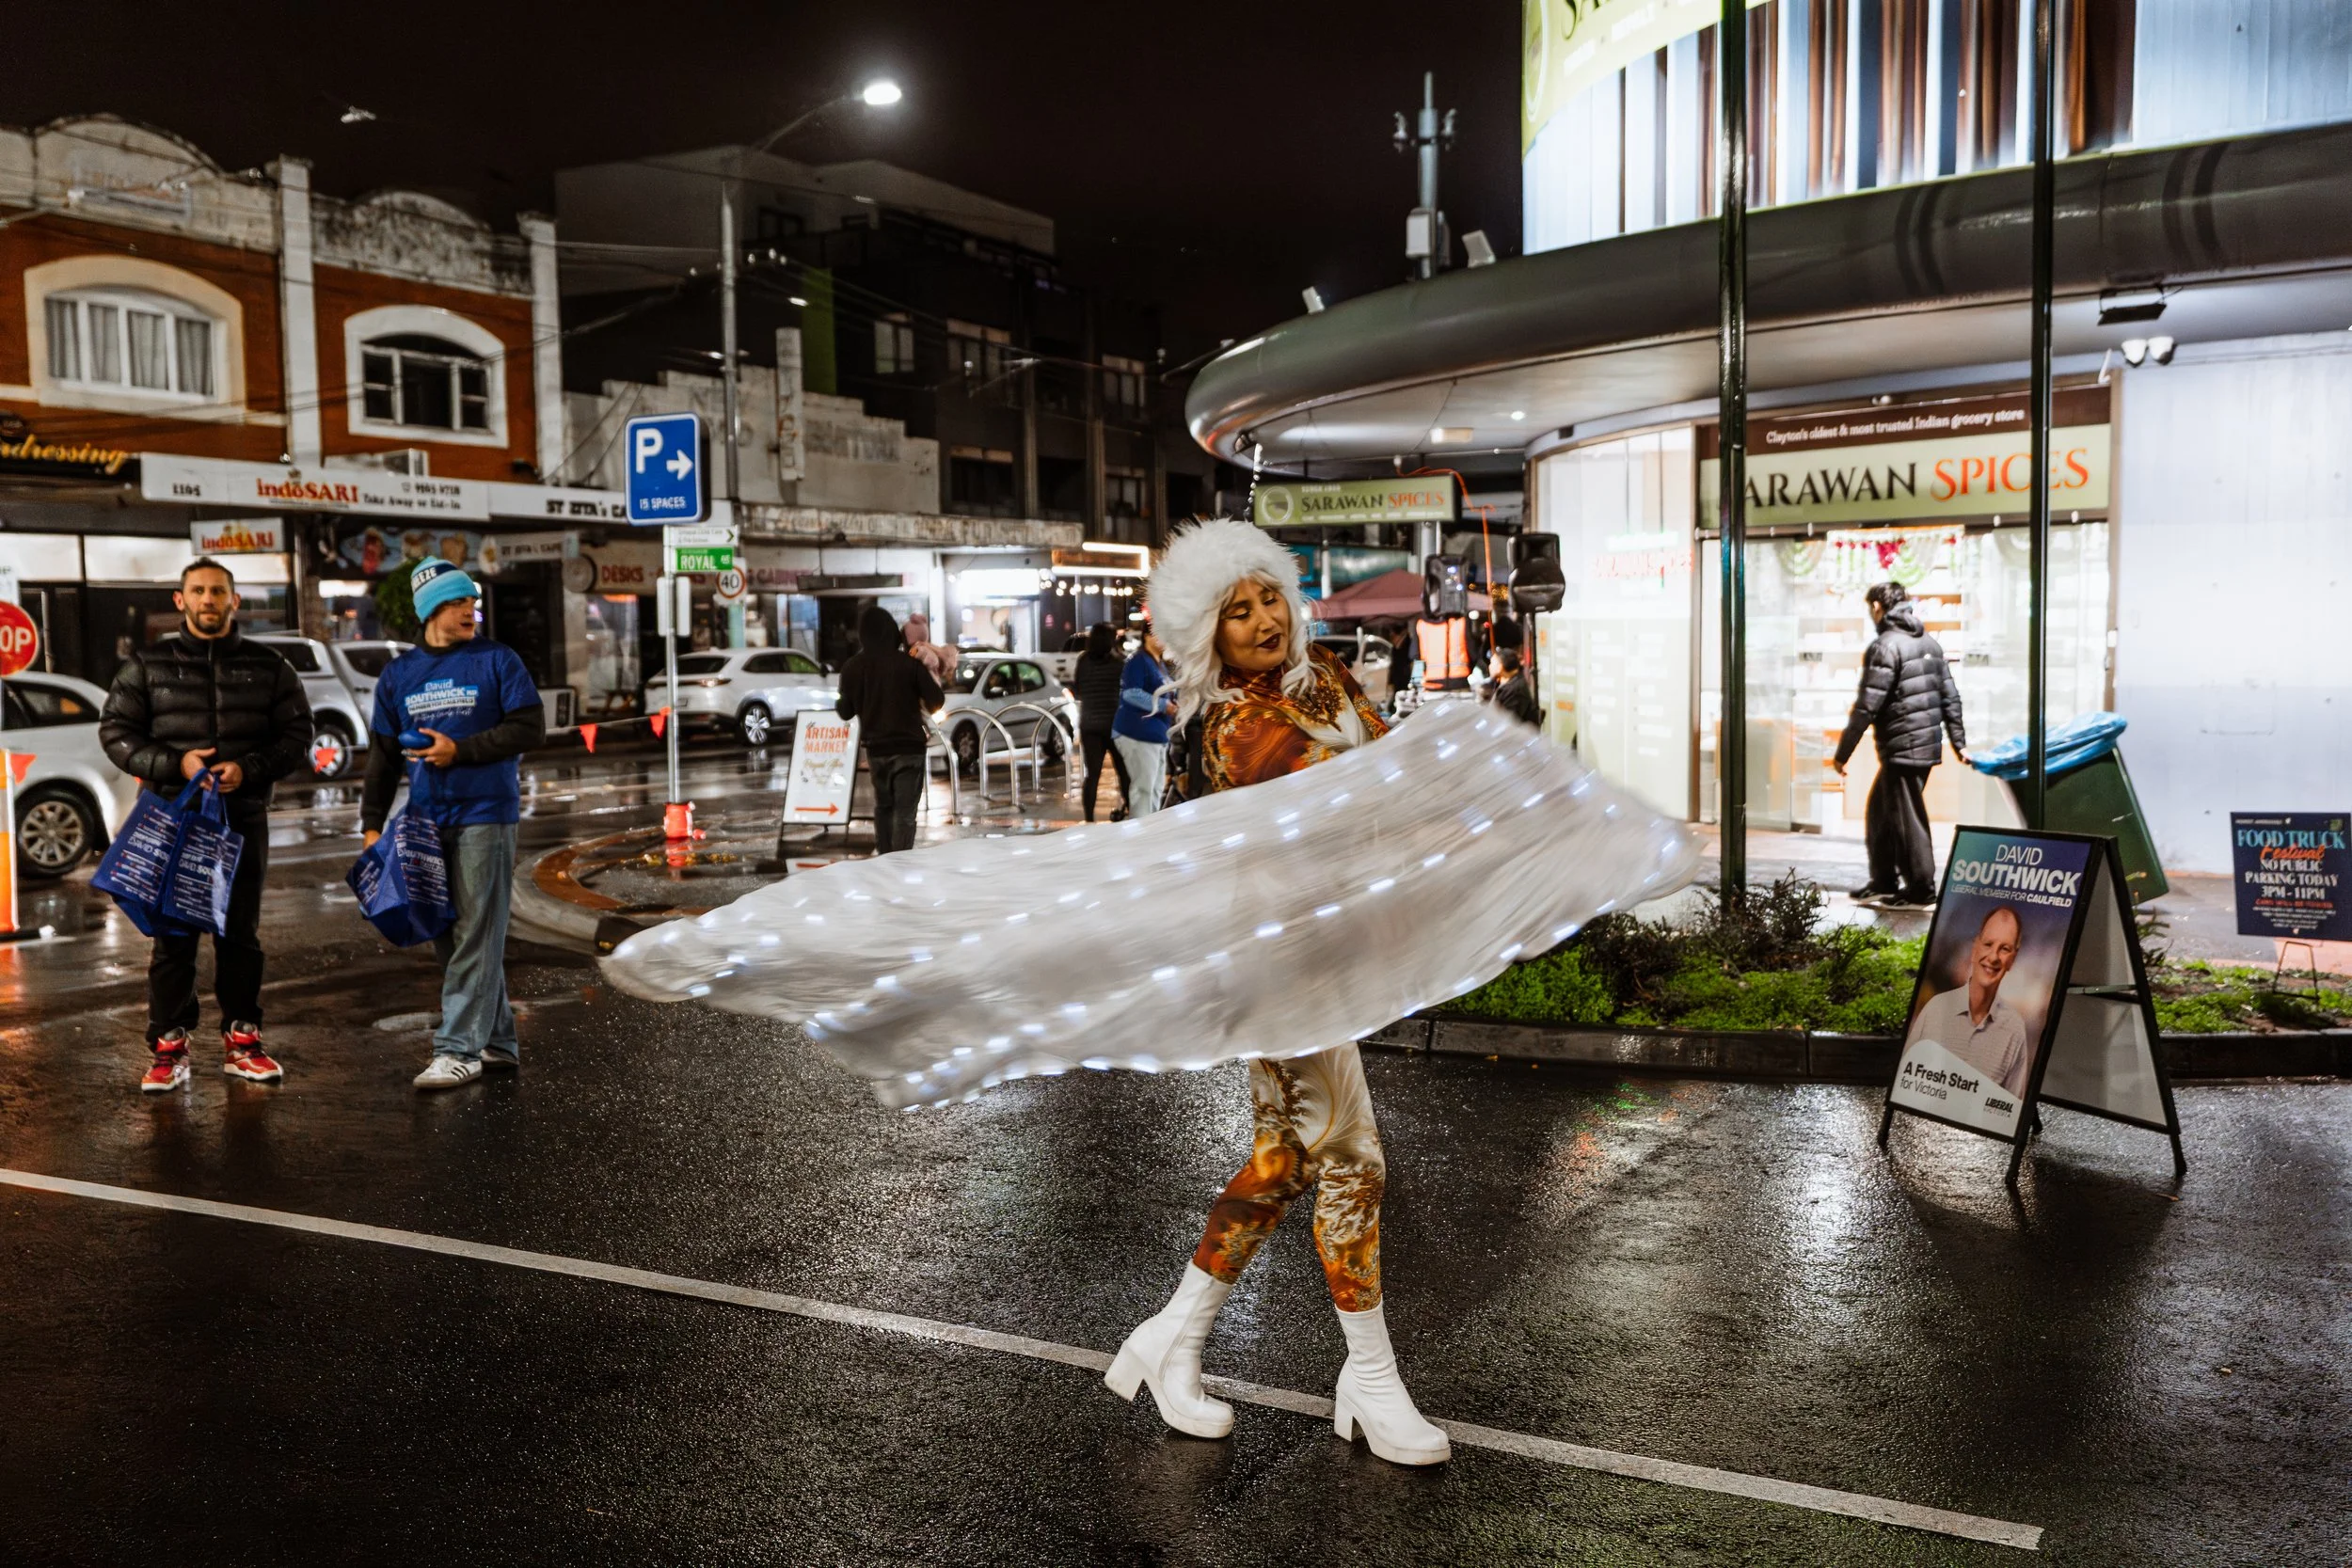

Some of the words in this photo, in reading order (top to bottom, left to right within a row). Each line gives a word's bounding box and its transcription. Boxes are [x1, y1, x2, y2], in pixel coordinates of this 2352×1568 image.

[1766, 427, 1808, 444] Clayton's
[1809, 426, 1838, 440] oldest
[1839, 424, 1849, 436] &
[1850, 423, 1875, 436] most
[1876, 417, 1914, 434] trusted
[1915, 415, 1950, 430] Indian
[1950, 412, 1994, 430] grocery
[1994, 409, 2025, 421] store
[636, 427, 664, 474] P
[1743, 462, 1916, 509] ARAWAN
[546, 499, 564, 515] ST
[651, 496, 687, 511] SPACES
[1301, 493, 1384, 513] SARAWAN
[1388, 491, 1445, 509] SPICES
[680, 554, 718, 569] ROYAL
[602, 565, 644, 583] DESKS
[721, 574, 739, 589] 40
[425, 678, 453, 691] David
[405, 687, 466, 706] SOUTHWICK
[804, 726, 850, 739] ARTISAN
[804, 740, 847, 753] MARKET
[2237, 829, 2284, 847] FOOD
[2284, 831, 2345, 849] TRUCK
[1995, 844, 2042, 865] DAVID
[2260, 843, 2326, 860] Festival
[2261, 859, 2278, 872] NO
[2280, 859, 2324, 872] PUBLIC
[1952, 859, 2081, 895] SOUTHWICK
[2245, 870, 2296, 885] PARKING
[2297, 873, 2339, 887] TODAY
[1951, 884, 1977, 895] LIBERAL
[1979, 887, 2010, 900] MEMBER
[2010, 892, 2027, 901] FOR
[2026, 893, 2073, 908] CAULFIELD
[2262, 885, 2286, 898] 3PM
[2294, 887, 2326, 900] 11PM
[1903, 1061, 1914, 1075] A
[1915, 1064, 1947, 1085] Fresh
[1948, 1072, 1979, 1093] Start
[1900, 1075, 1913, 1089] for
[1915, 1080, 1947, 1100] Victoria
[1984, 1097, 2014, 1113] LIBERAL
